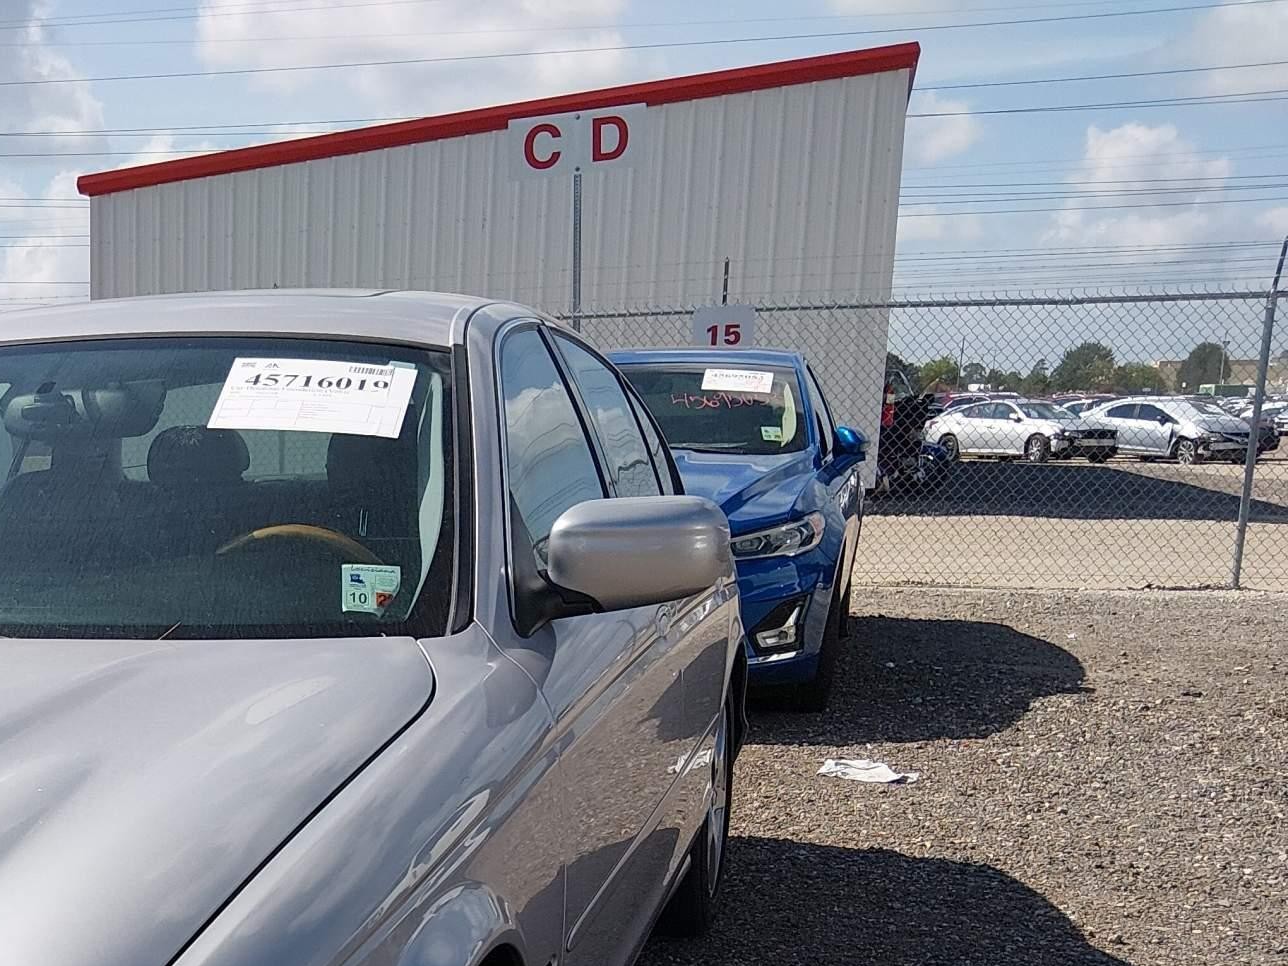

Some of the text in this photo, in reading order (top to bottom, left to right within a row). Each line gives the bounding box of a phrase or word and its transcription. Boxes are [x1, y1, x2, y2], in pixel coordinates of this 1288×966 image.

[524, 115, 629, 170] C D
[706, 324, 741, 346] 15
[244, 373, 390, 393] 45716019
[350, 592, 367, 604] 10
